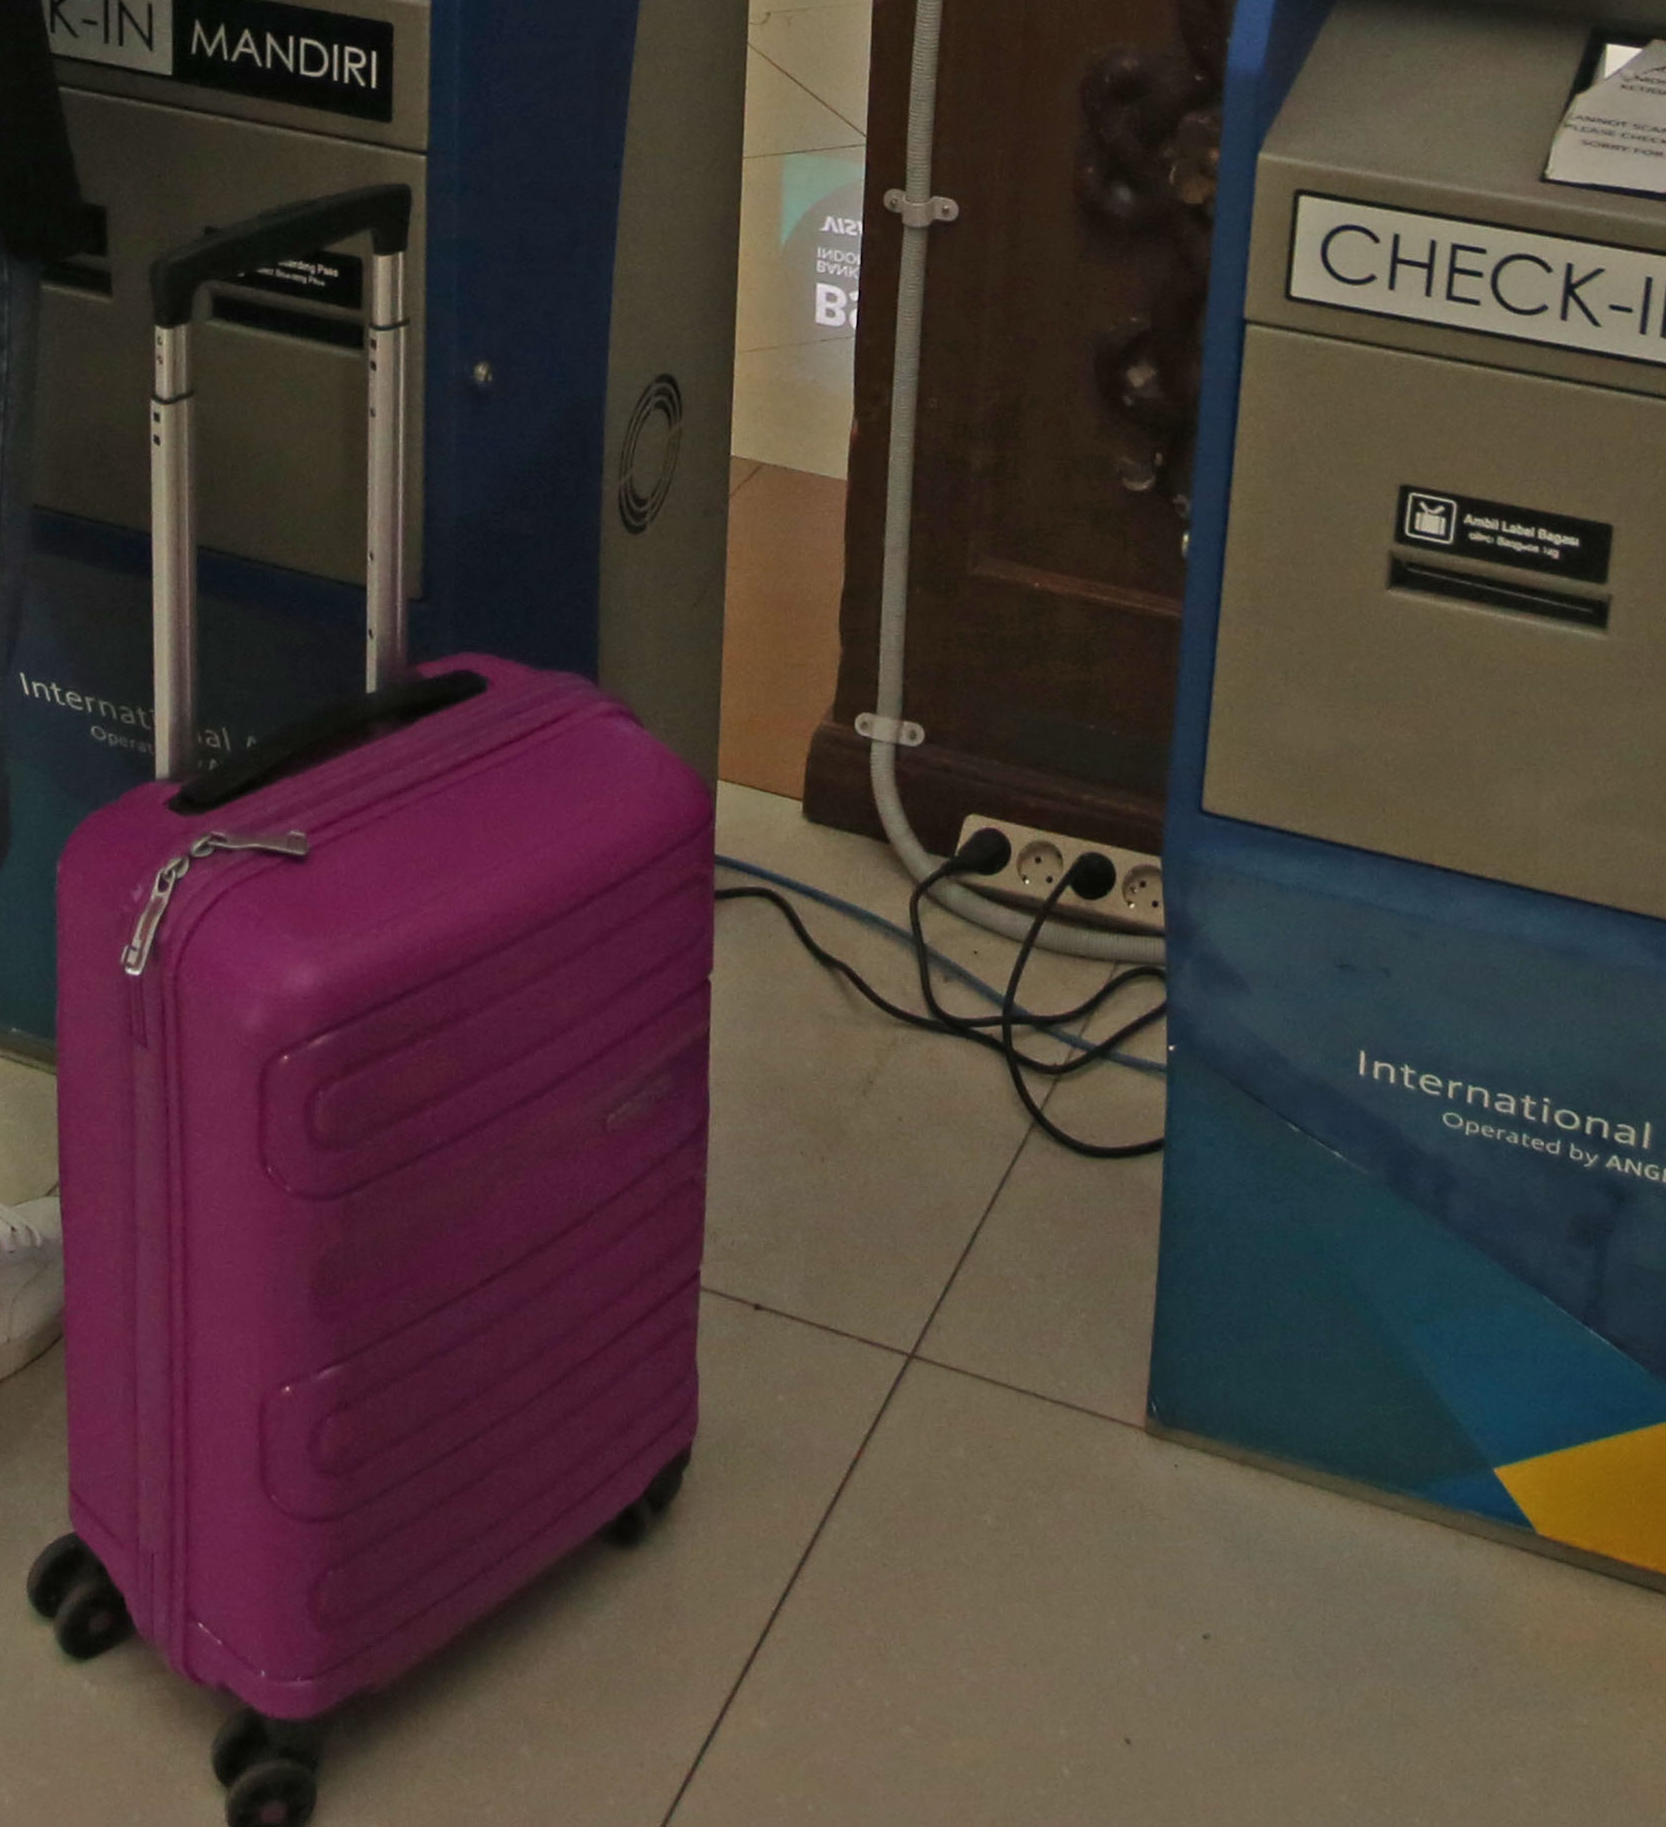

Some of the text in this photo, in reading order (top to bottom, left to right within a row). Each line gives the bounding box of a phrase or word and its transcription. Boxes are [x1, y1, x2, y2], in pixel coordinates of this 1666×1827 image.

[191, 19, 378, 90] MANDIRI
[1463, 513, 1499, 530] Ambil
[1501, 520, 1536, 538] Label
[1537, 528, 1580, 547] Bagasi
[1357, 1050, 1652, 1149] International
[1442, 1111, 1561, 1156] Operated
[1568, 1143, 1599, 1168] by
